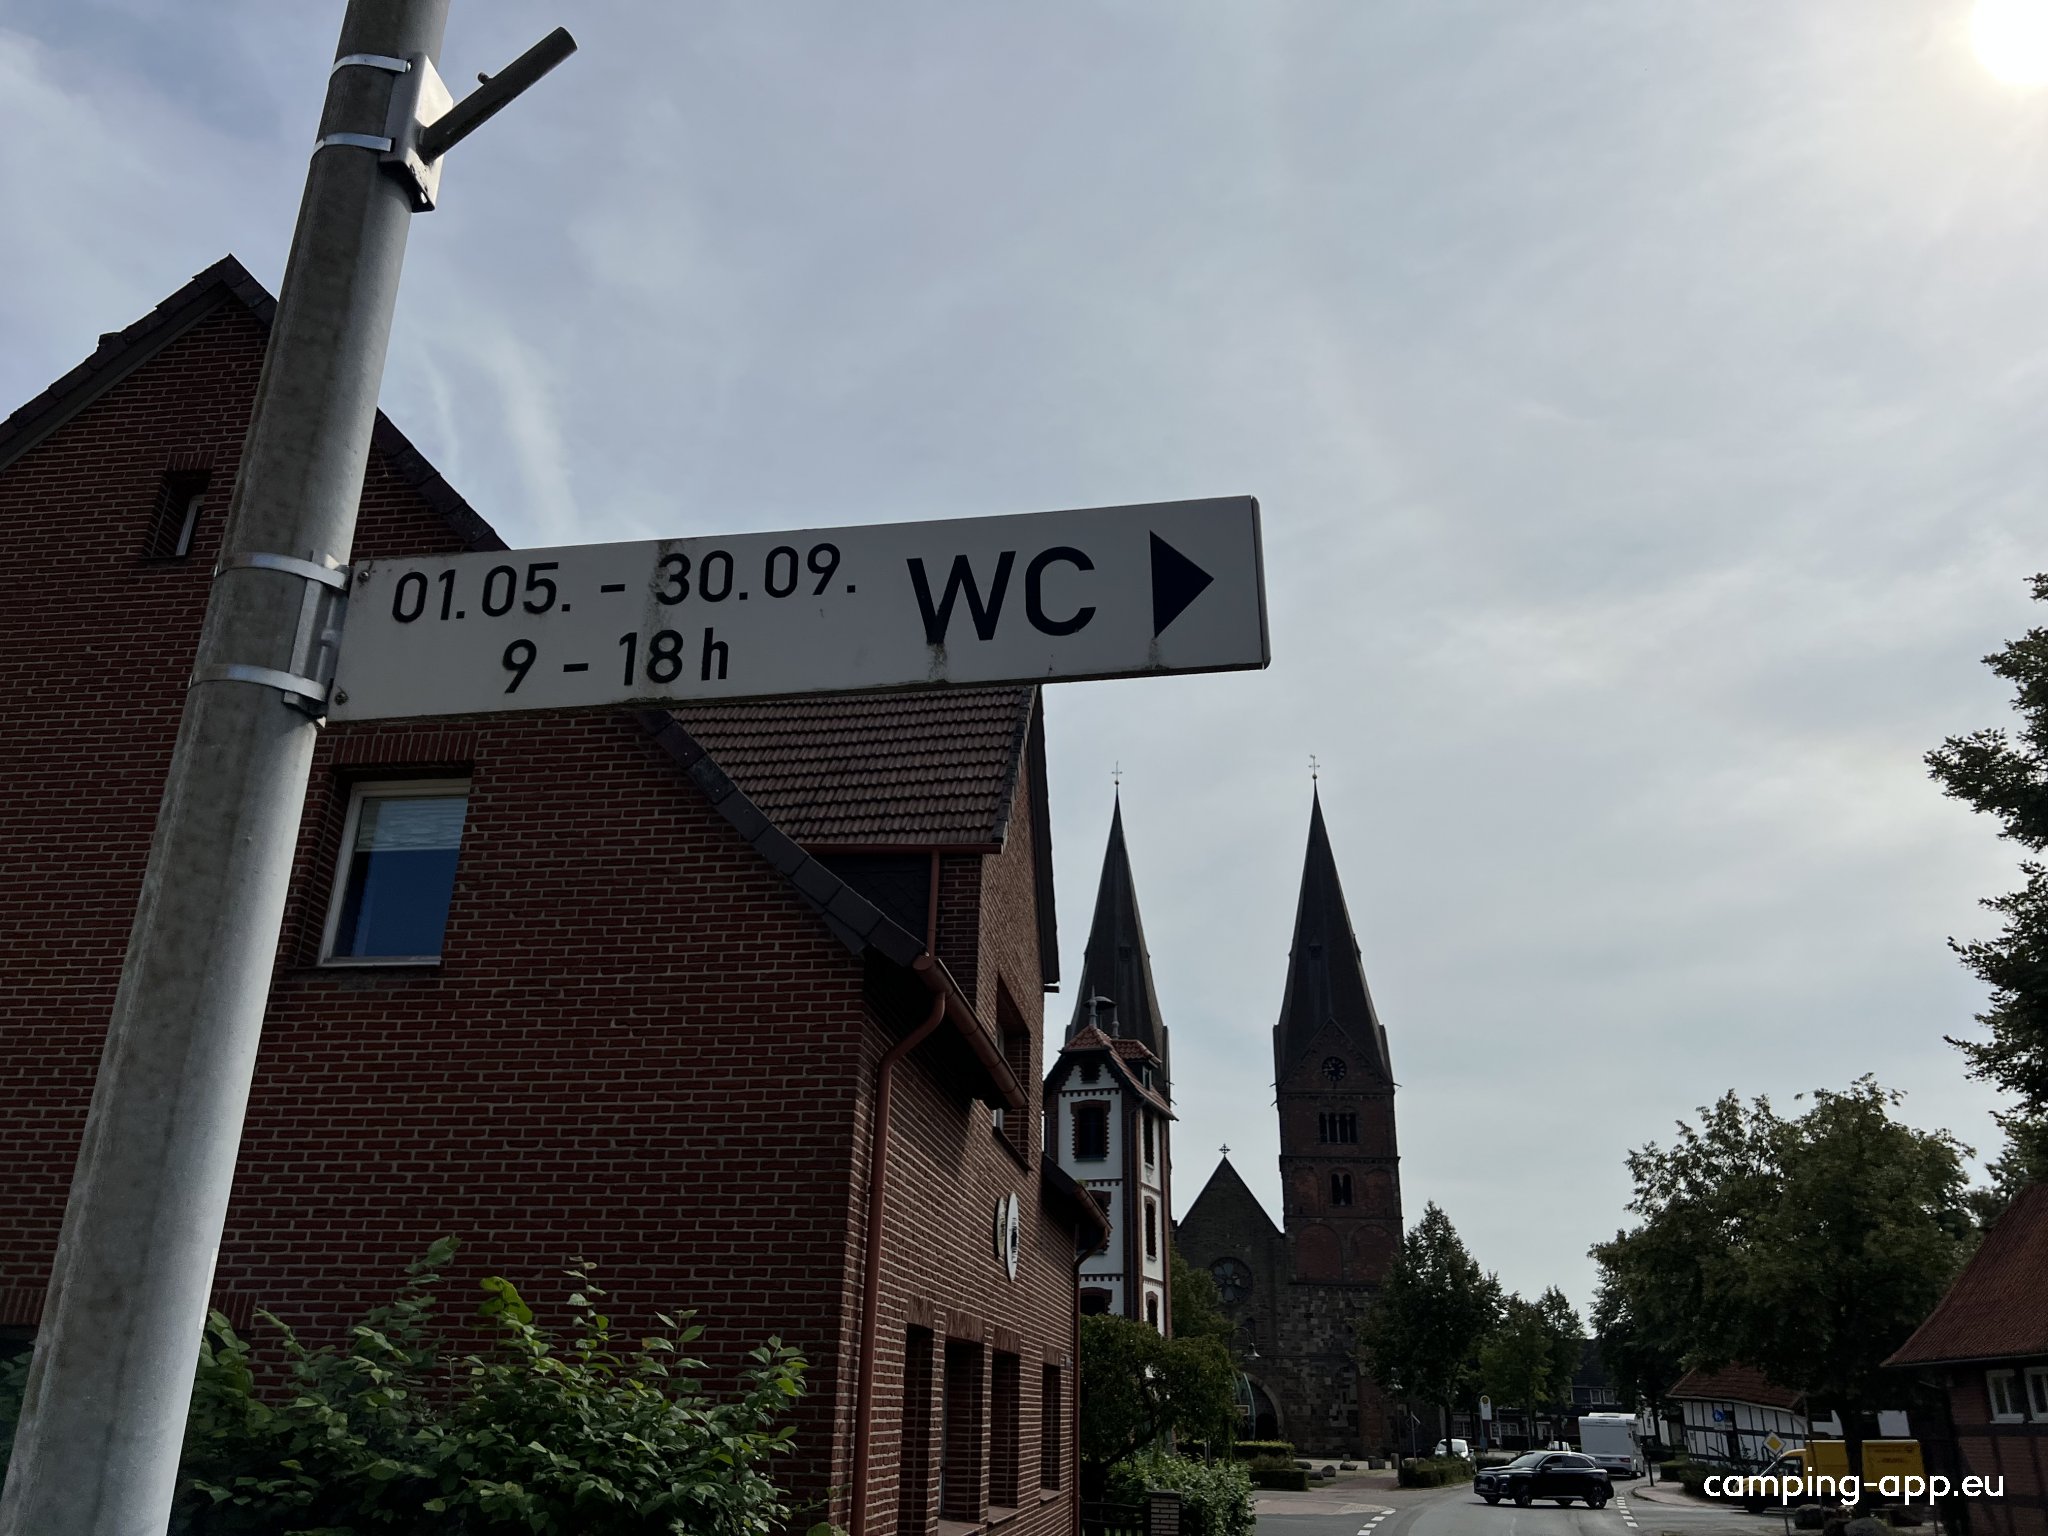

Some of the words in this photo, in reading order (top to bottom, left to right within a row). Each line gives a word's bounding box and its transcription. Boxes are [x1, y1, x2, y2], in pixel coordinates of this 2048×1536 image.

[392, 561, 571, 625] 01.05.
[656, 543, 857, 606] 30.09.
[906, 546, 1097, 646] WC
[502, 639, 537, 694] 9
